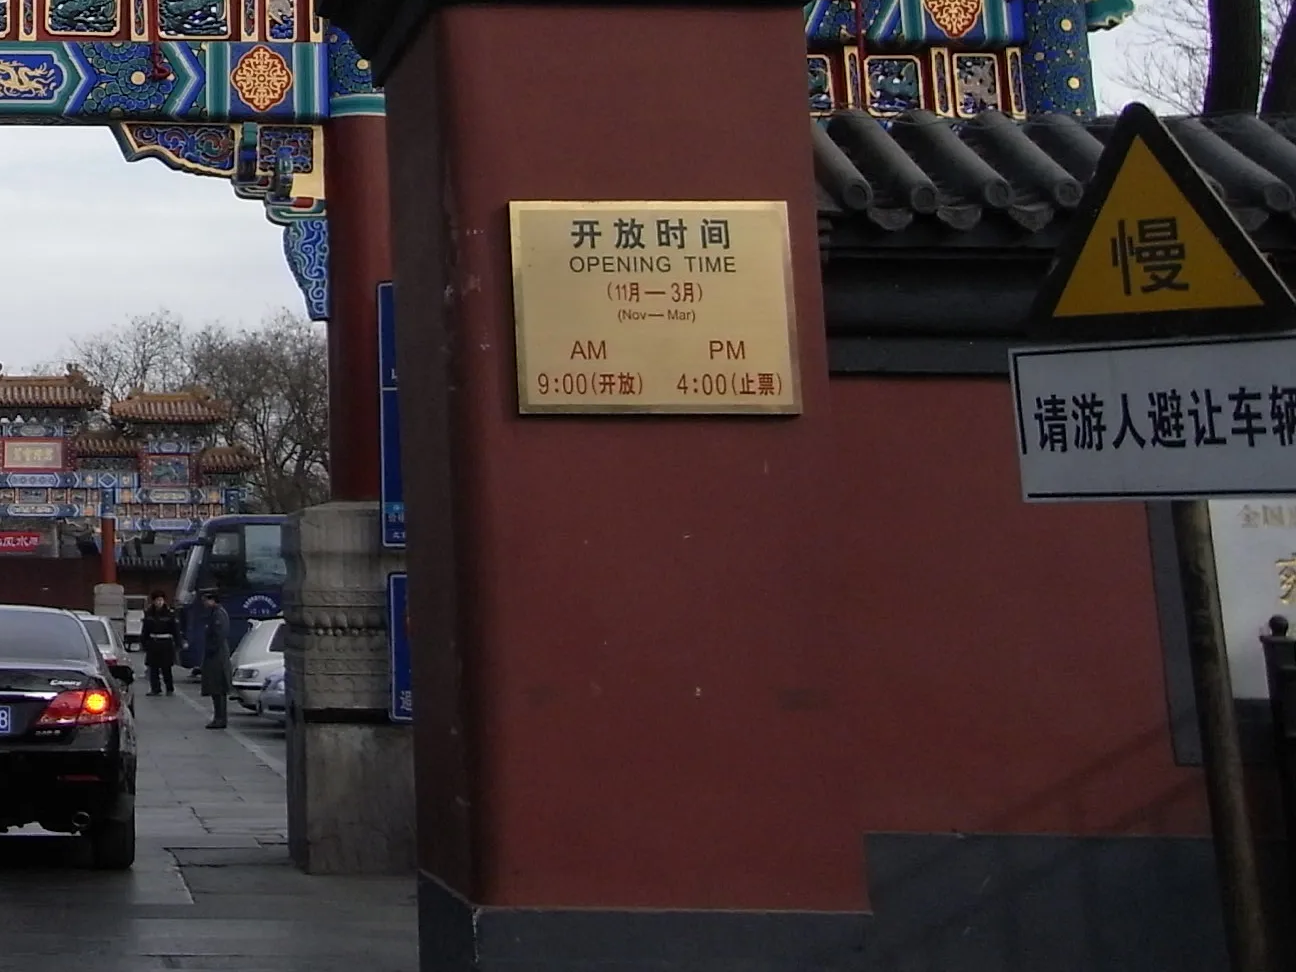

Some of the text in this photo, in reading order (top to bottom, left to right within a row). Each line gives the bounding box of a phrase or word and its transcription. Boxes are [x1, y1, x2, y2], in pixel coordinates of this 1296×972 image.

[570, 218, 731, 249] 开放时间
[569, 256, 737, 273] OPENING TIME
[1110, 217, 1190, 296] 慢
[570, 340, 746, 360] AM PM
